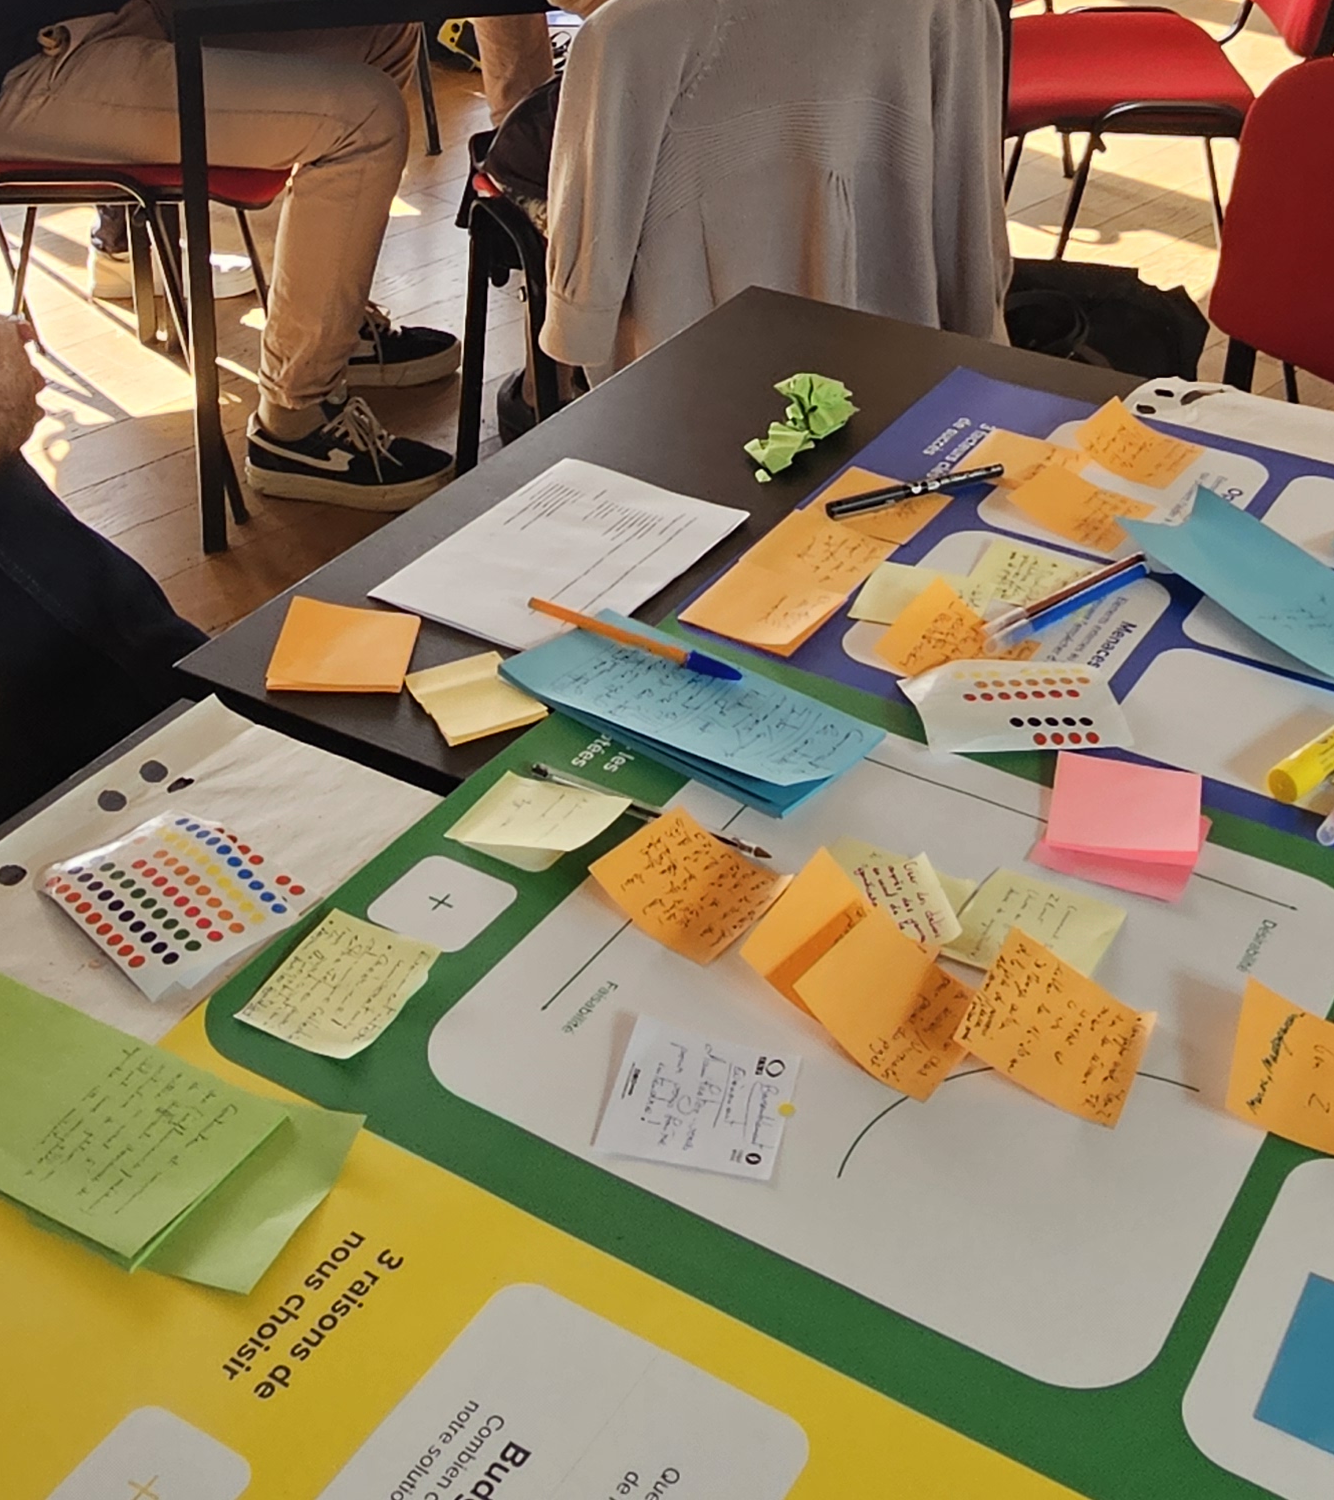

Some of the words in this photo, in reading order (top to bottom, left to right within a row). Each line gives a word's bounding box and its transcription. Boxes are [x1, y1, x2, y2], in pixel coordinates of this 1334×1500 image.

[1086, 619, 1137, 670] Menaces
[603, 751, 635, 773] les
[1236, 918, 1278, 973] Désirabilité
[561, 980, 619, 1035] Faisabilité
[304, 1230, 367, 1292] nous
[377, 1248, 406, 1272] 3
[221, 1292, 307, 1382] choisir
[288, 1269, 381, 1363] raisons
[253, 1362, 293, 1400] de
[438, 1399, 480, 1445] notre
[389, 1443, 443, 1500] solutio
[436, 1413, 506, 1490] Combien
